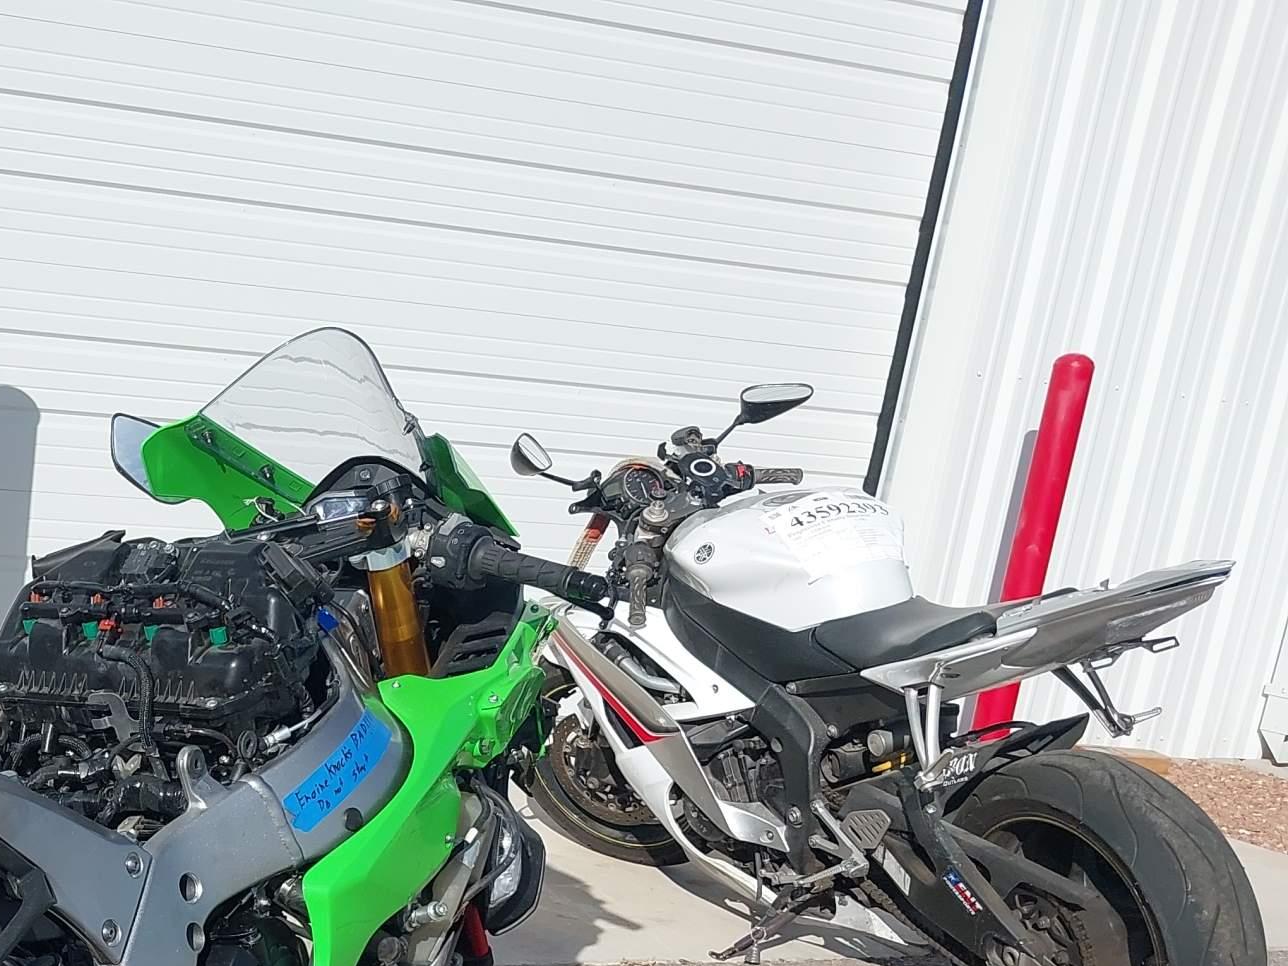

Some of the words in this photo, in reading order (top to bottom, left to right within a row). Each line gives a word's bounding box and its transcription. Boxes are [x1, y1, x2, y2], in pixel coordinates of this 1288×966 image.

[790, 502, 889, 527] 43592393
[295, 779, 329, 810] Engine
[317, 799, 331, 812] Do
